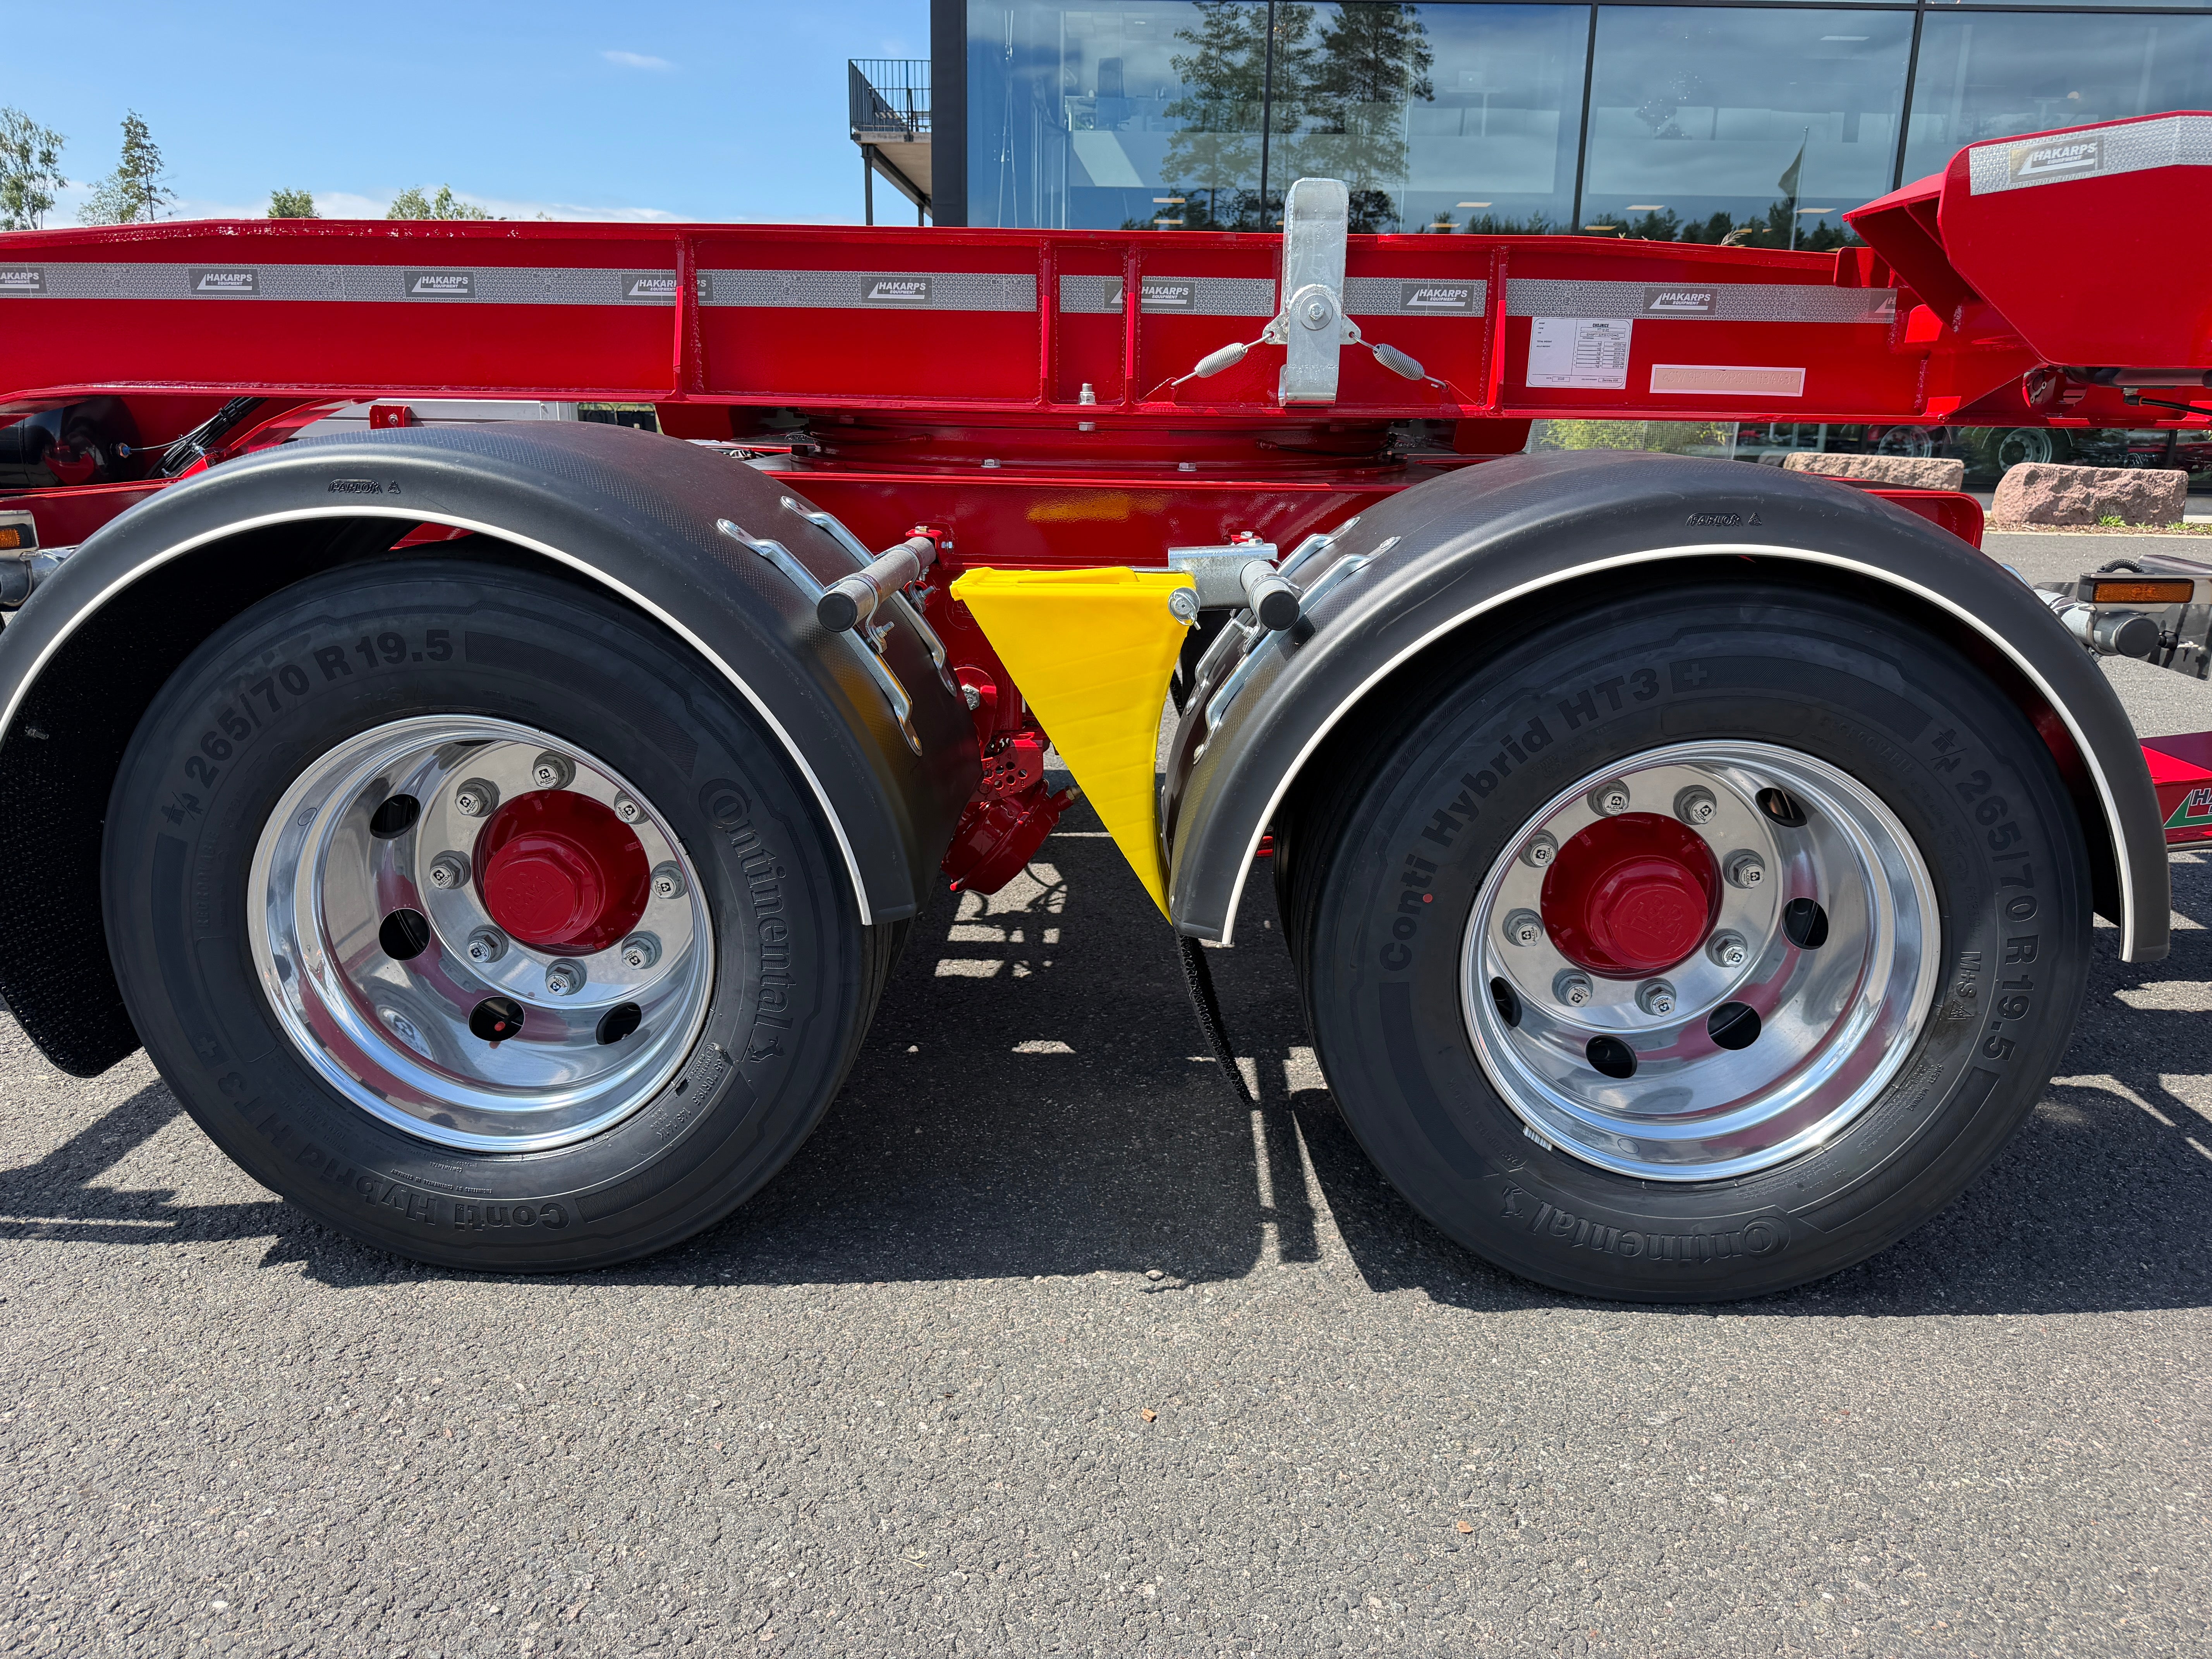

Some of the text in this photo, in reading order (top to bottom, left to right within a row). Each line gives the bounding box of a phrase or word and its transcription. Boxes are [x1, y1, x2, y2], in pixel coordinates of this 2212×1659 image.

[2032, 143, 2097, 161] HAKARPS
[422, 276, 468, 284] HAKARPS
[879, 282, 926, 290] HAKARPS
[1141, 287, 1189, 295] HAKARPS
[1419, 289, 1468, 298] HAKARPS
[1662, 293, 1711, 301] HAKARPS
[330, 483, 380, 493] PARLOK
[1689, 515, 1740, 526] PARLOK
[184, 629, 453, 788] 265/70 R 19.5
[466, 800, 478, 813] ALCOA
[618, 807, 629, 821] ALCOA
[1379, 853, 1438, 971] Conti
[1421, 716, 1554, 847] Hybrid
[1556, 668, 1659, 730] HT3
[1693, 809, 1706, 822] ALCOA
[438, 875, 451, 886] ALCOA
[699, 778, 796, 1030] Continental
[1955, 769, 2039, 1062] 265/70 R 19.5
[477, 942, 487, 957] ALCOA
[623, 950, 637, 960] ALCOA
[1956, 951, 1982, 998] M+S
[553, 975, 567, 988] ALCOA
[1574, 987, 1589, 997] ALCOA
[1652, 997, 1668, 1006] ALCOA
[1905, 1063, 1945, 1113] SAFETY WARNING
[218, 1072, 295, 1147] HT3
[429, 1161, 462, 1173] CONTINENTAL
[296, 1142, 438, 1226] Hybrid
[422, 1178, 453, 1190] CONTINENTAL
[455, 1202, 570, 1231] Conti
[1525, 1200, 1791, 1263] Continental
